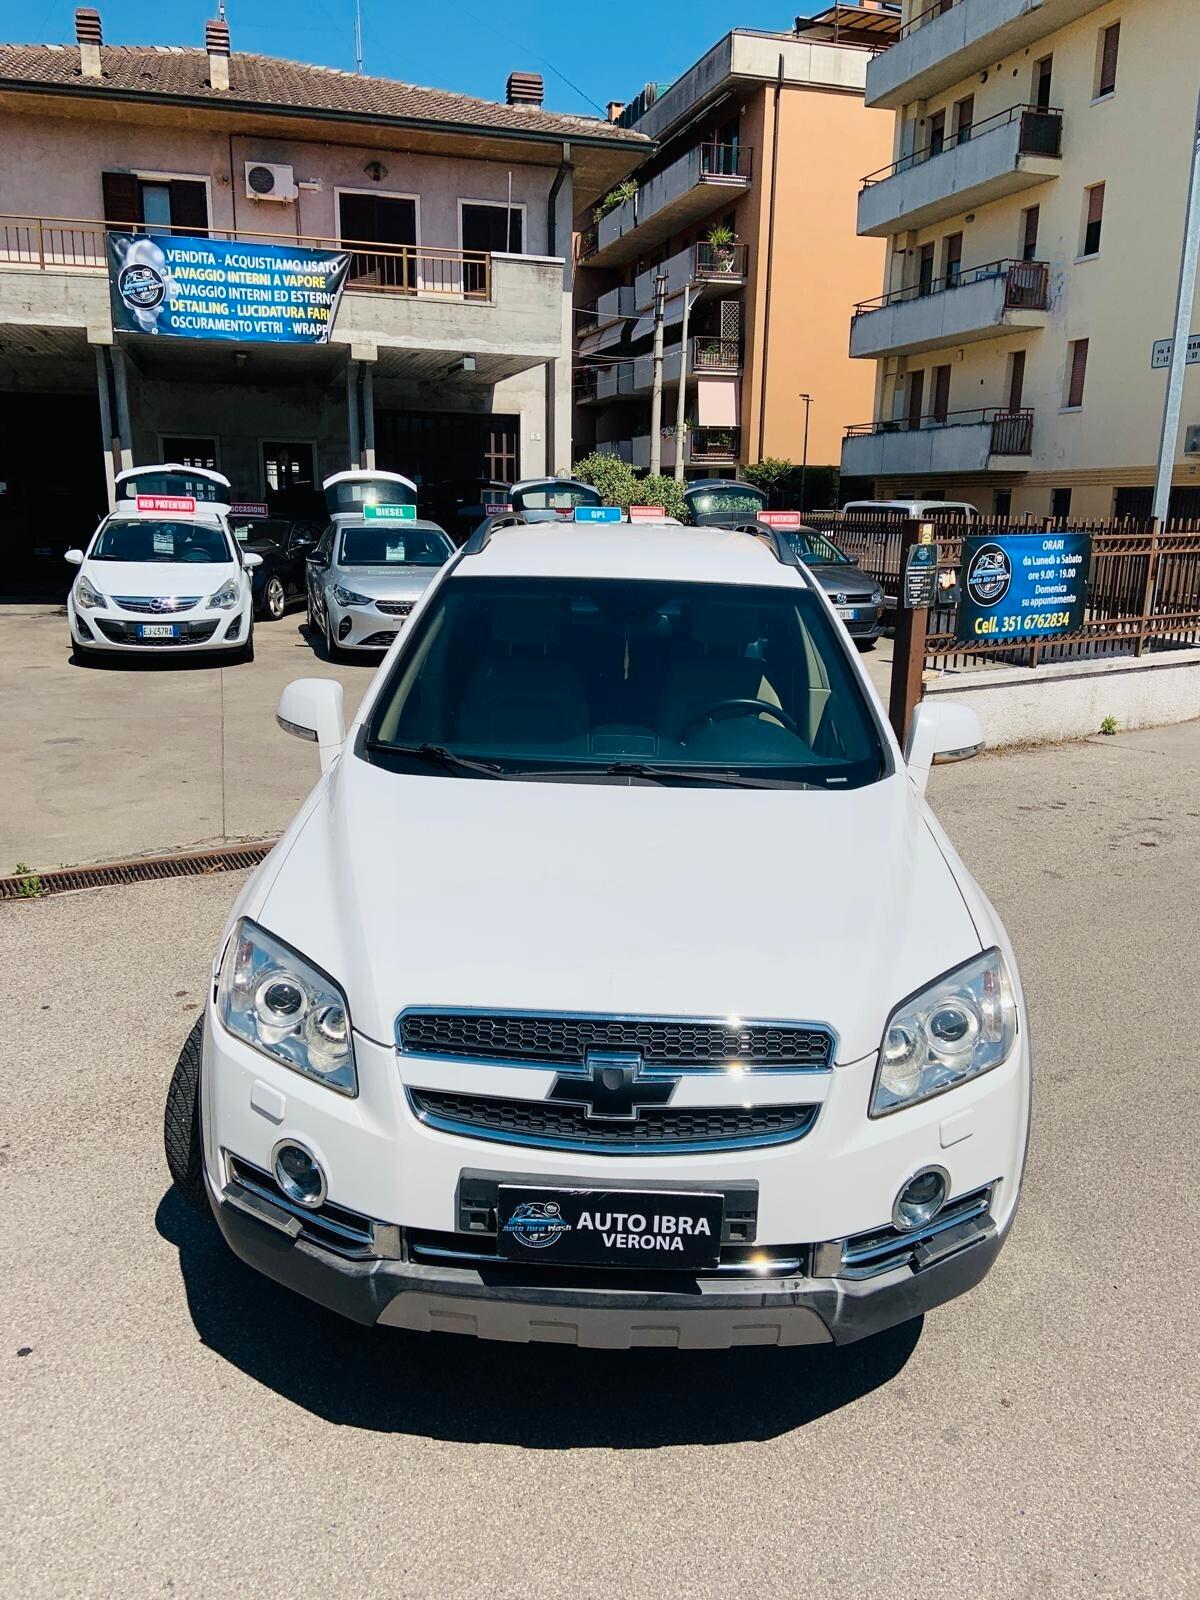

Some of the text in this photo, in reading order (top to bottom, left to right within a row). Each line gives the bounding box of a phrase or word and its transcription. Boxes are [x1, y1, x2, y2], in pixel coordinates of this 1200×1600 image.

[166, 249, 216, 265] VENDITA
[224, 254, 301, 270] ACQUISTIAMO
[303, 261, 339, 274] USATO
[167, 266, 326, 288] LAVAGGIO INTERNI A VAPORE
[169, 282, 227, 299] LAVAGGIO
[228, 287, 272, 302] INTERNI
[274, 290, 289, 303] ED
[169, 299, 229, 315] DETAILING
[237, 304, 306, 319] LUCIDATURA
[170, 315, 253, 333] OSCURAMENTO
[253, 321, 283, 334] VETRI
[139, 499, 193, 510] NEO PATENTATI
[375, 507, 404, 517] DIESEL
[591, 510, 606, 519] GPL
[1042, 540, 1064, 551] ORARI
[1022, 556, 1032, 566] da
[1061, 553, 1083, 564] Sabato
[1028, 572, 1040, 580] ore
[1040, 570, 1055, 580] 9.00
[1059, 568, 1077, 579] 19.00
[1035, 583, 1067, 594] Domenica
[1021, 594, 1077, 608] su appuntamento
[974, 611, 1070, 635] Cell. 351 6762834
[502, 1224, 525, 1232] Auto
[547, 1224, 573, 1232] Wash
[576, 1211, 712, 1237] AUTO IBRA
[601, 1232, 684, 1252] VERONA
